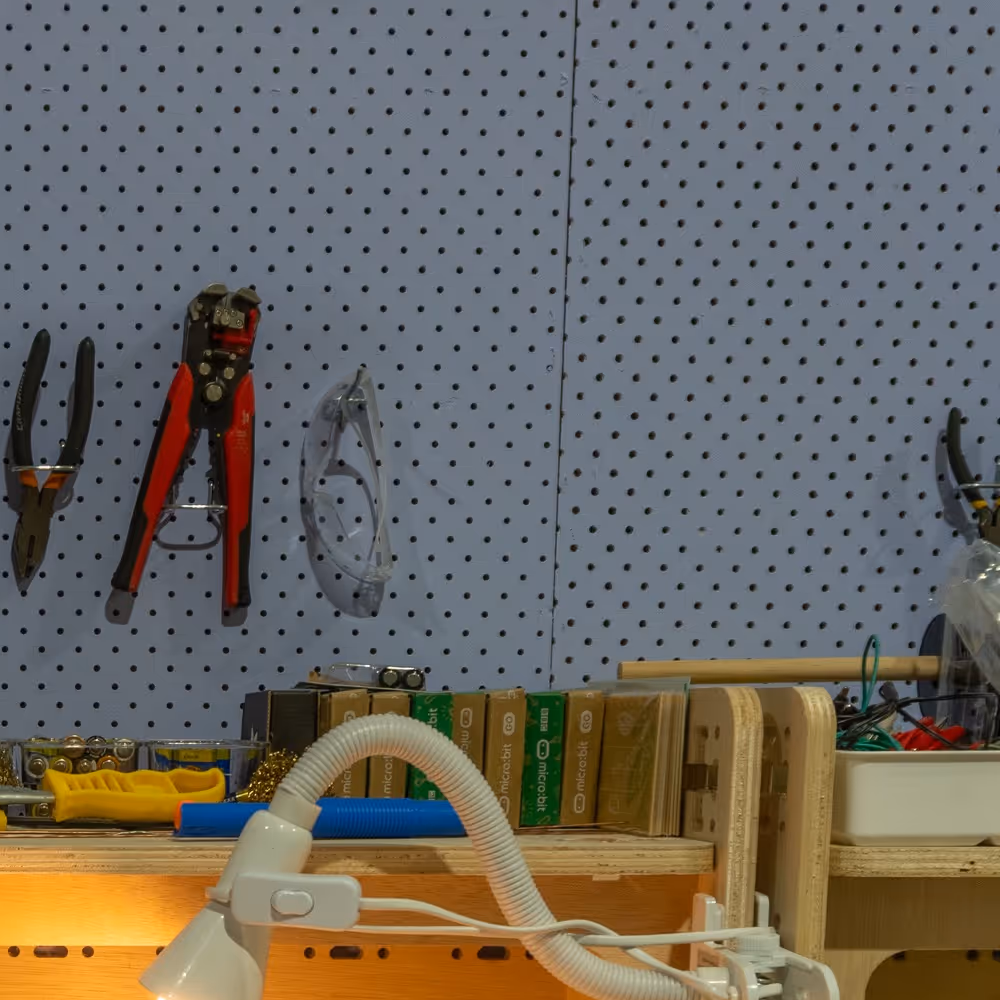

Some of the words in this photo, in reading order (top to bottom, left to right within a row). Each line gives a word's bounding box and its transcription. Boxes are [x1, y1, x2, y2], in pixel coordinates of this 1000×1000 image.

[500, 743, 512, 794] micro:bit
[536, 761, 549, 813] micro:bit
[575, 741, 589, 792] micro:bit
